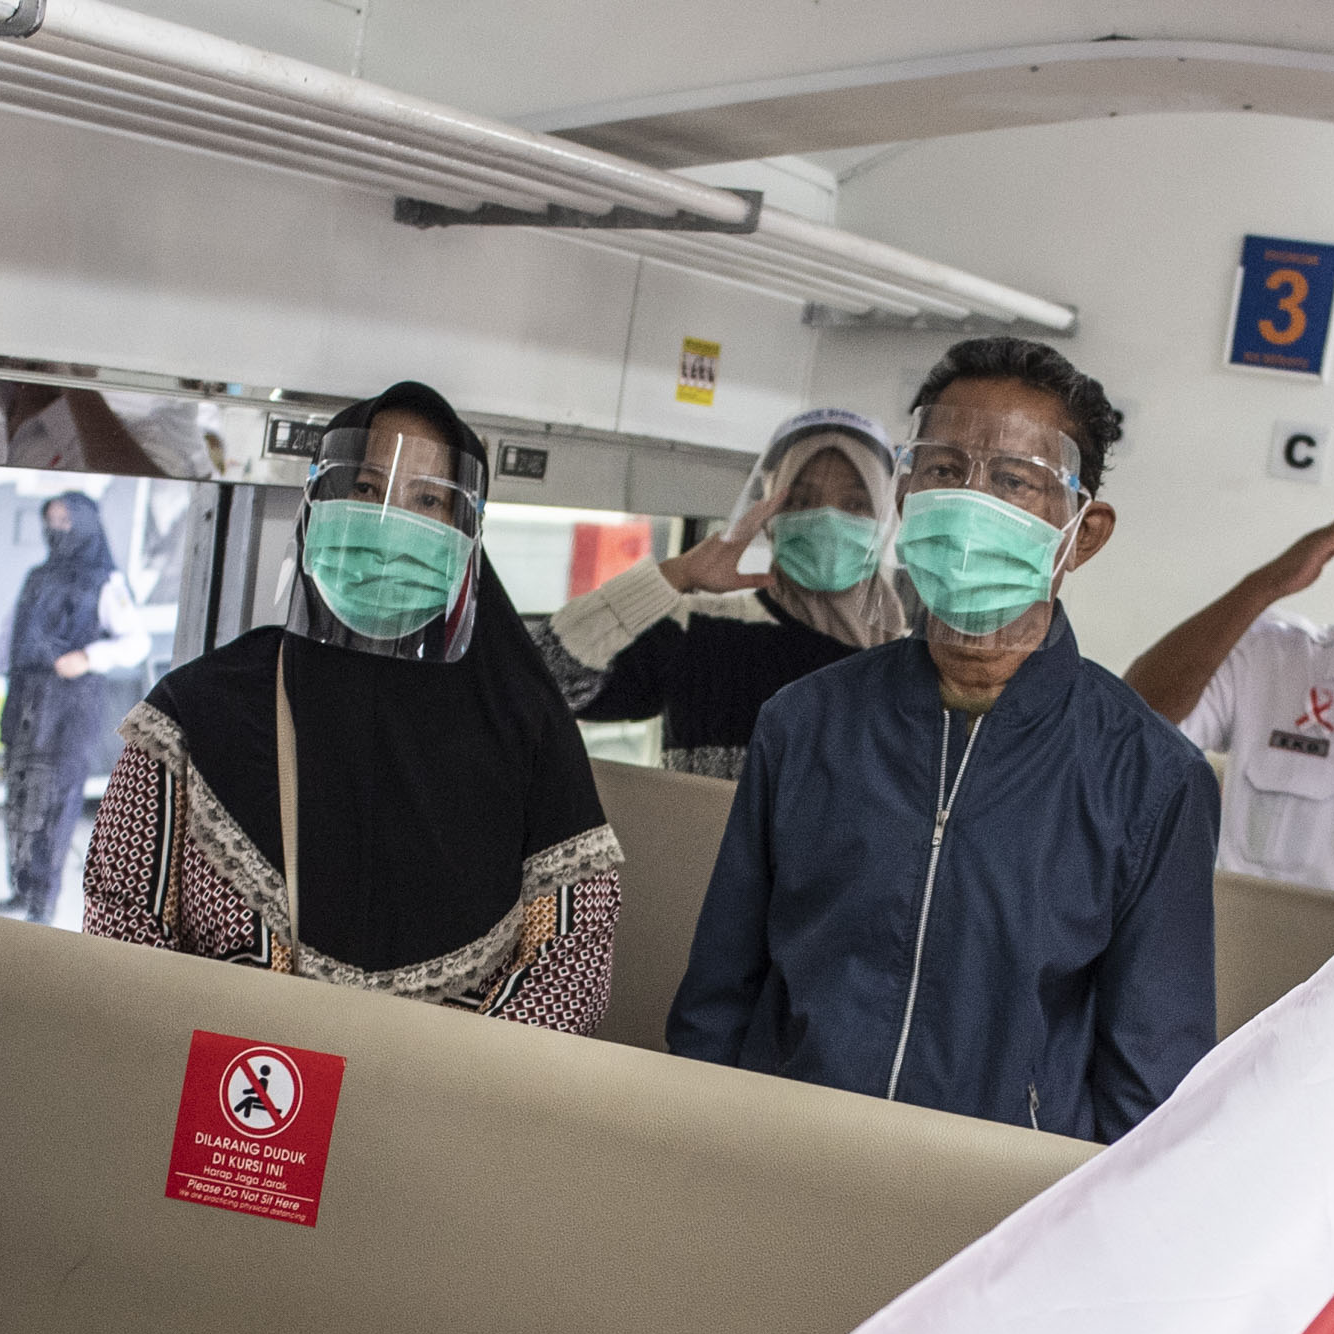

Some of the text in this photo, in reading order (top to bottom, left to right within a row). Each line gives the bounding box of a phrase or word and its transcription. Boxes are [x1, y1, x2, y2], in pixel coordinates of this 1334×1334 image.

[1258, 269, 1309, 345] 3
[1284, 433, 1316, 469] C
[194, 1131, 307, 1165] DILARANG DUDUK
[212, 1152, 284, 1177] DI KURSI INI
[203, 1165, 287, 1190] Harap Jaga Jarak
[187, 1178, 300, 1211] Please Do Not Sit Here
